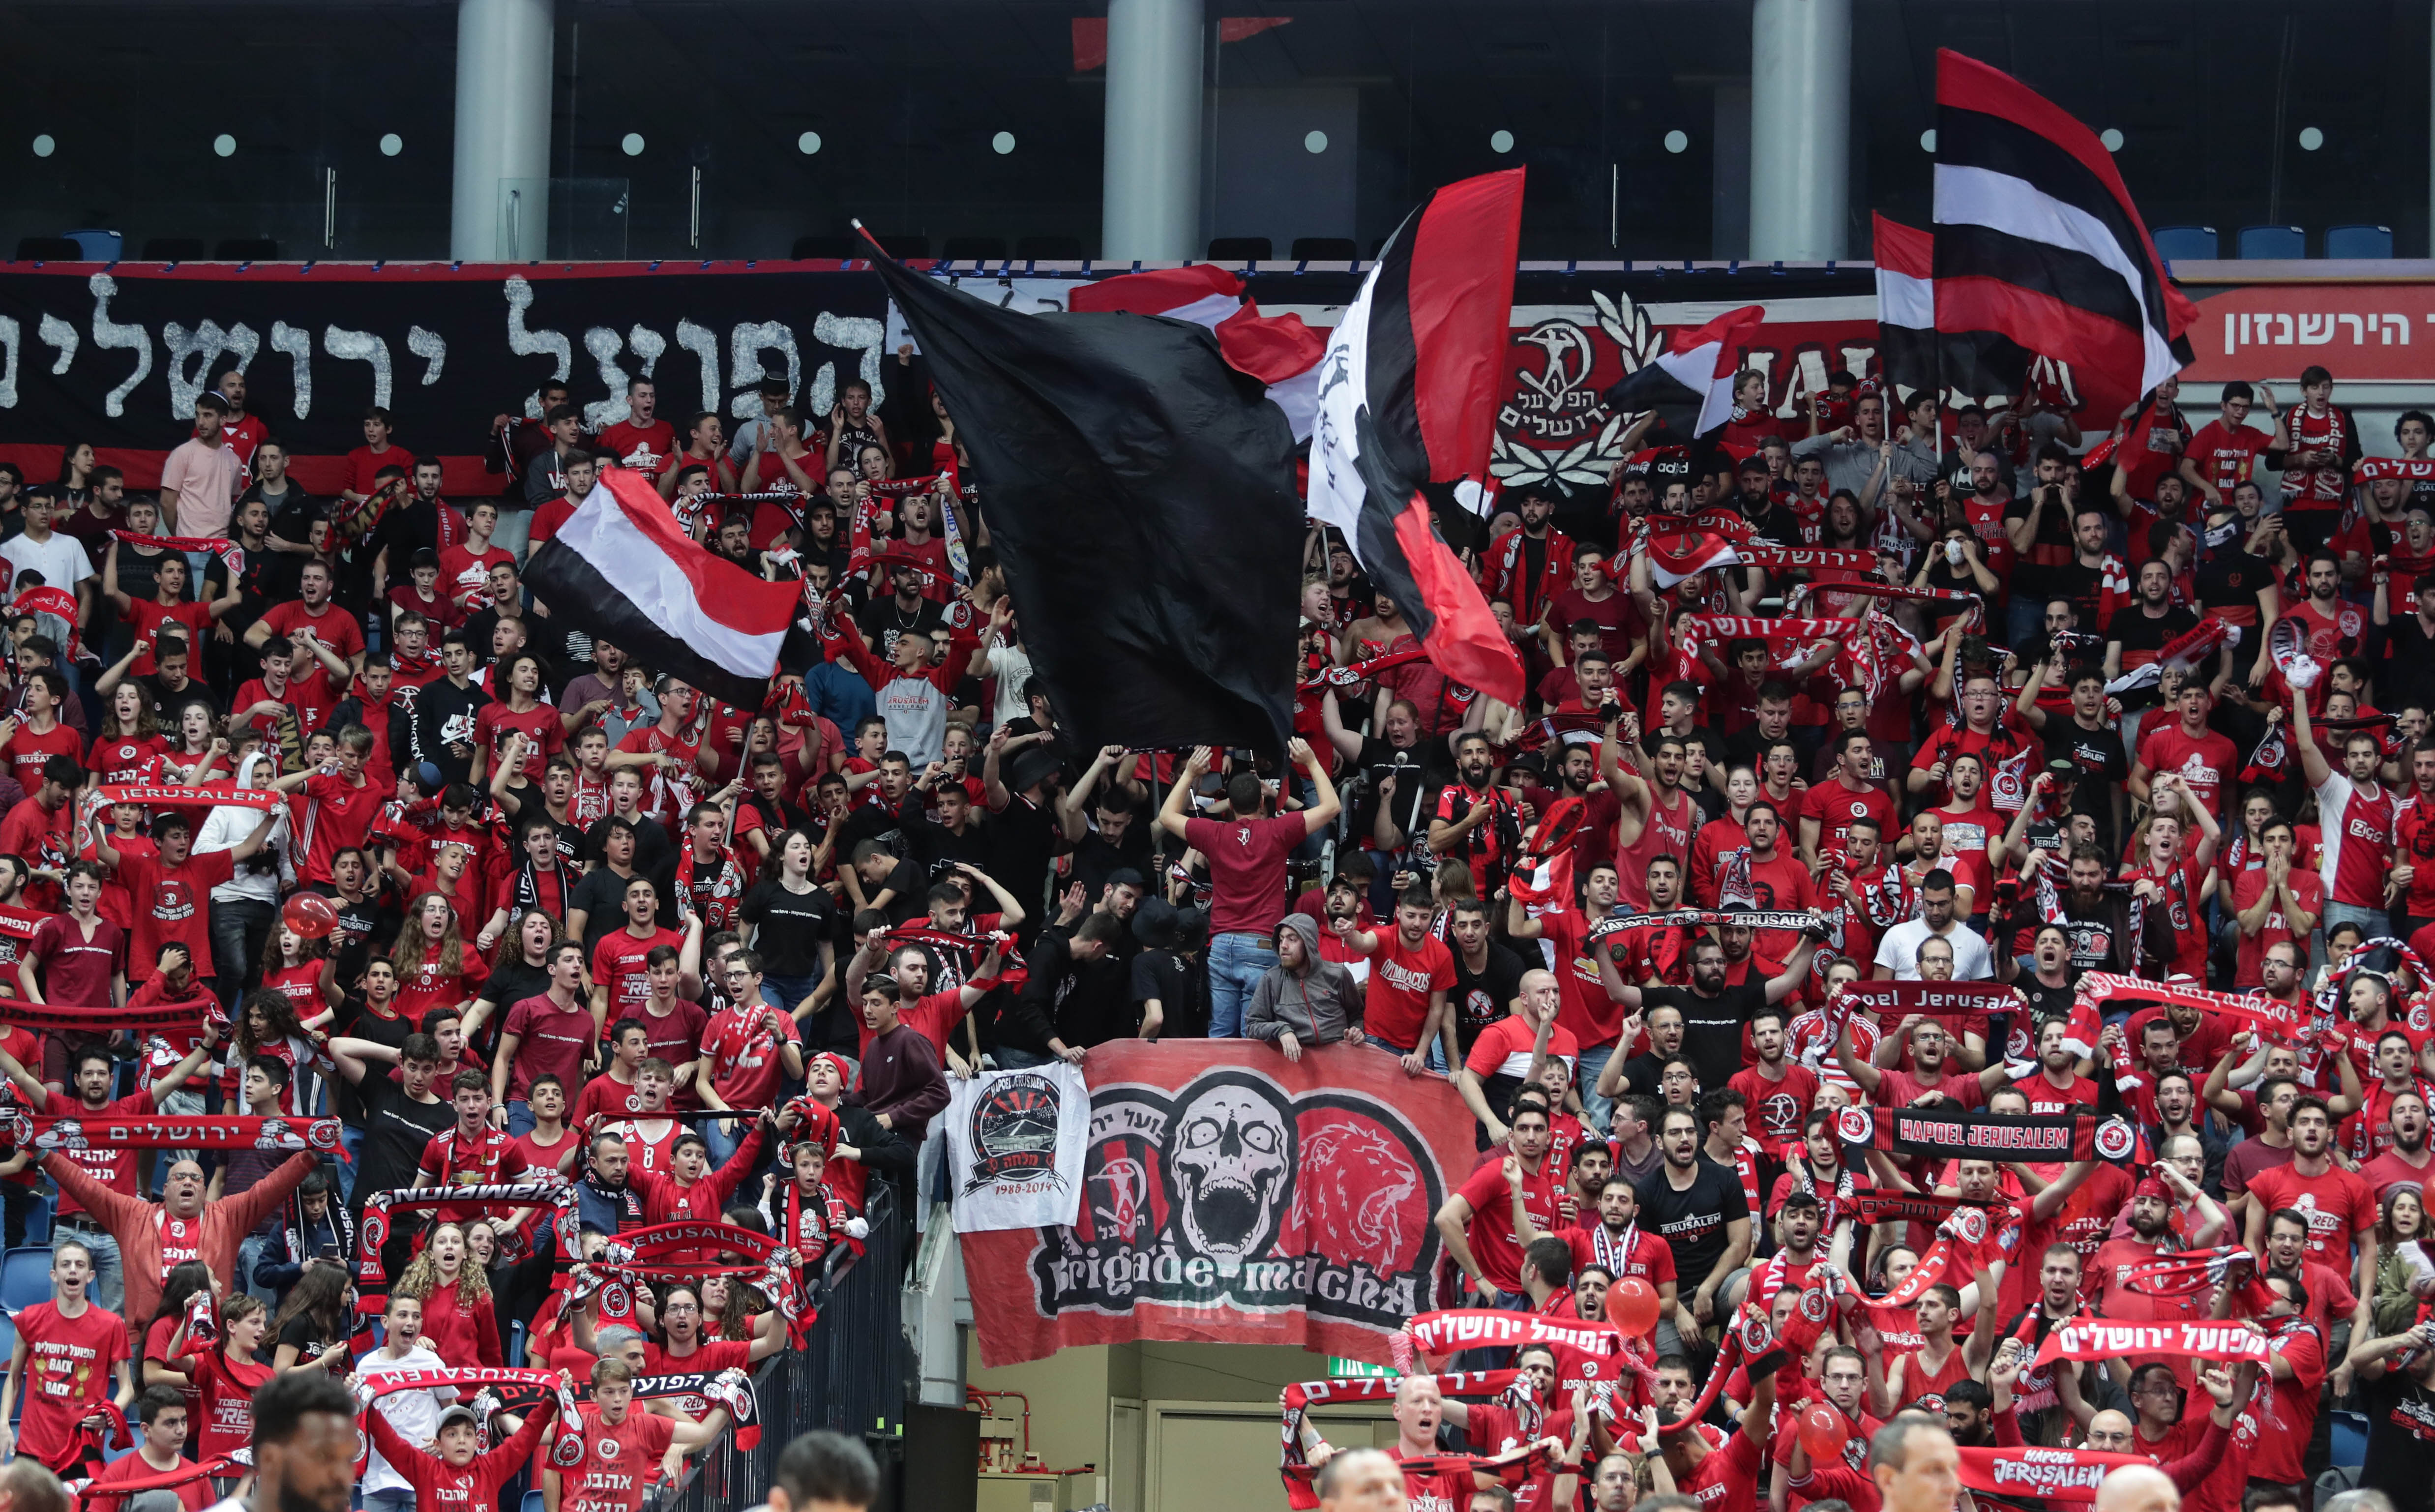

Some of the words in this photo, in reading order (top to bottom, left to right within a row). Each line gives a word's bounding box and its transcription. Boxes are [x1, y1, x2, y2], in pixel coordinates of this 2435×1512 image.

[2225, 313, 2409, 355] הירשנזון
[1499, 403, 1610, 437] ירושלים
[1741, 548, 1858, 566] ירושלים
[2201, 768, 2218, 781] RED
[121, 788, 267, 801] JERUSALEM
[2034, 837, 2061, 848] JERUS
[338, 918, 373, 931] ERUSALEM
[1732, 913, 1821, 931] JERUSALEM
[624, 973, 647, 981] TOGE
[284, 986, 312, 997] SALEM
[629, 981, 652, 996] RE
[1914, 990, 2021, 1011] Jerusale
[2222, 993, 2288, 1023] ירושלים
[2353, 1037, 2376, 1052] ROC
[990, 1076, 1011, 1097] HAPOEL
[1011, 1074, 1045, 1091] JERUSALEM
[109, 1122, 239, 1141] ירושלים
[1900, 1118, 1965, 1145] HAPOEL
[1967, 1124, 2069, 1150] JERUSALEM
[642, 1146, 655, 1169] 8
[1003, 1152, 1039, 1168] מלחה
[1661, 1214, 1722, 1234] JERUSALEM
[2313, 1216, 2336, 1227] RED
[628, 1225, 762, 1253] JERUSALEM
[1883, 1333, 1925, 1345] ERUSAL
[2059, 1322, 2172, 1353] ירושלים
[2181, 1323, 2267, 1356] הפועל
[34, 1341, 69, 1356] ירושלים
[70, 1344, 96, 1359] הפועל
[48, 1358, 73, 1374] BACK
[382, 1368, 552, 1386] JERUSALEM
[1562, 1379, 1590, 1391] BORN
[45, 1381, 70, 1396] BACK
[683, 1397, 703, 1408] RED
[222, 1408, 251, 1425] RE
[2023, 1449, 2076, 1464] HAPOEL
[1992, 1458, 2107, 1489] JERUSALEM
[436, 1487, 469, 1501] אהבה
